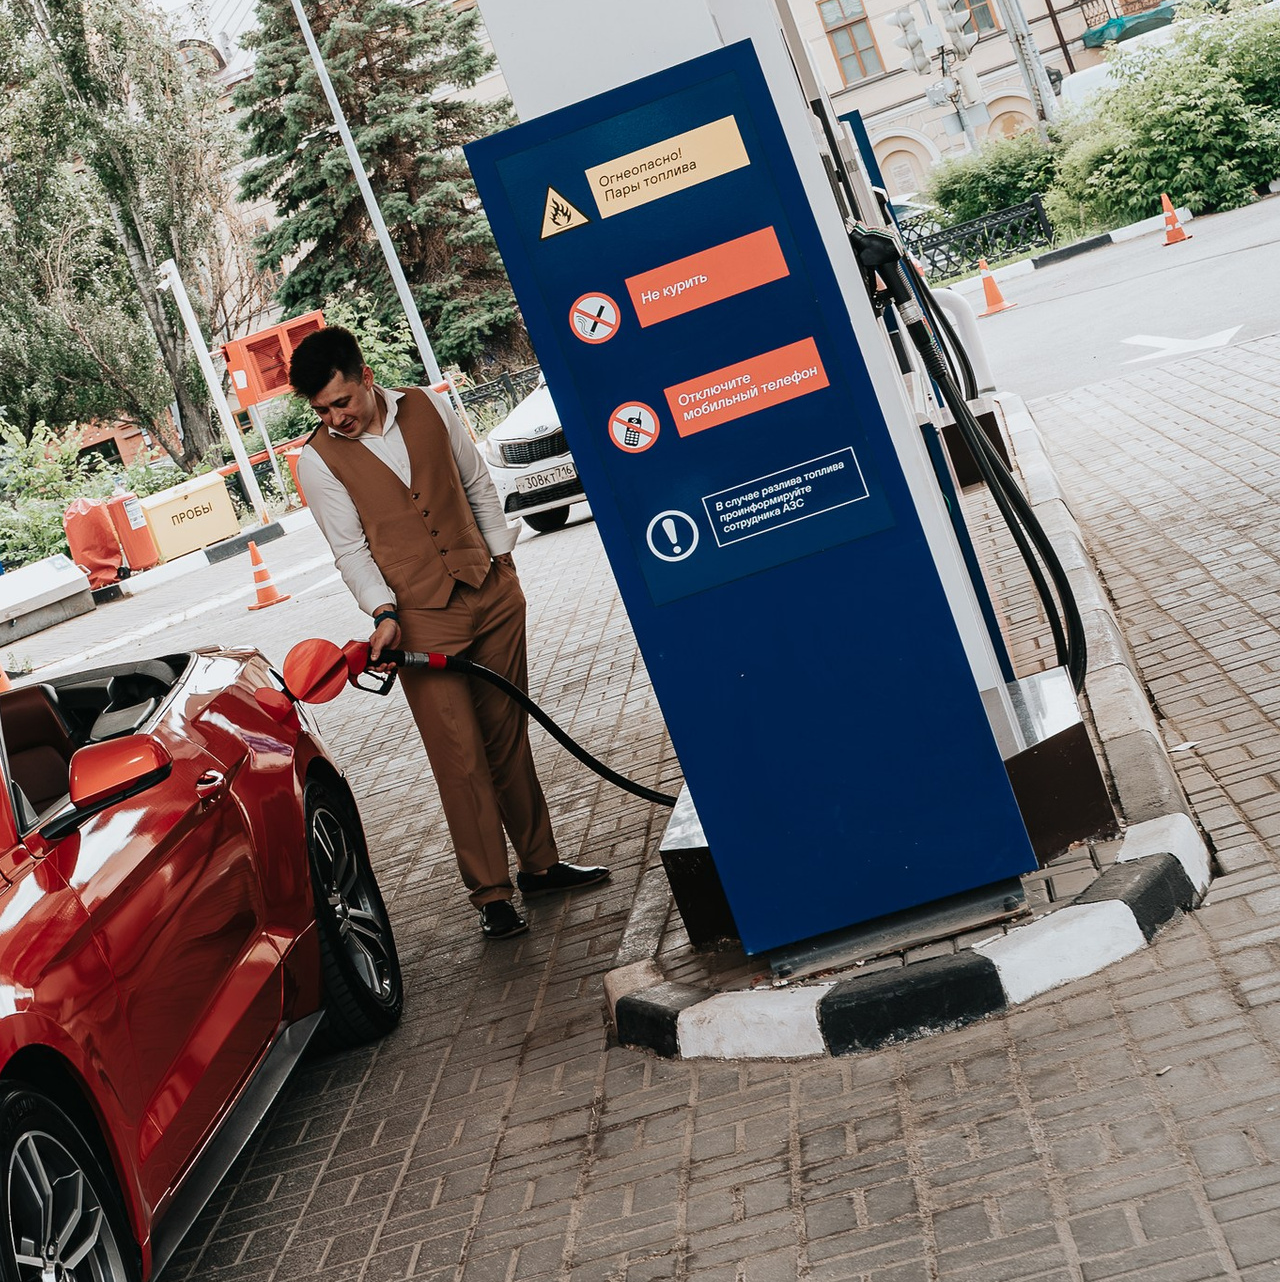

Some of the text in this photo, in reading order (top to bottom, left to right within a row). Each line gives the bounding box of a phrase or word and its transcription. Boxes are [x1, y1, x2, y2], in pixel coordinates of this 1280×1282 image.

[599, 148, 682, 187] Огнеопасно!
[605, 161, 697, 202] Пары топлива
[641, 274, 708, 305] Не курить
[678, 374, 751, 406] Отключите
[683, 366, 818, 421] мобильный телефон
[715, 461, 845, 511] В случае разлива топлива
[719, 485, 812, 522] проинформируйте
[171, 502, 212, 526] ПРОБЫ
[723, 498, 805, 533] сотрудника АЗС
